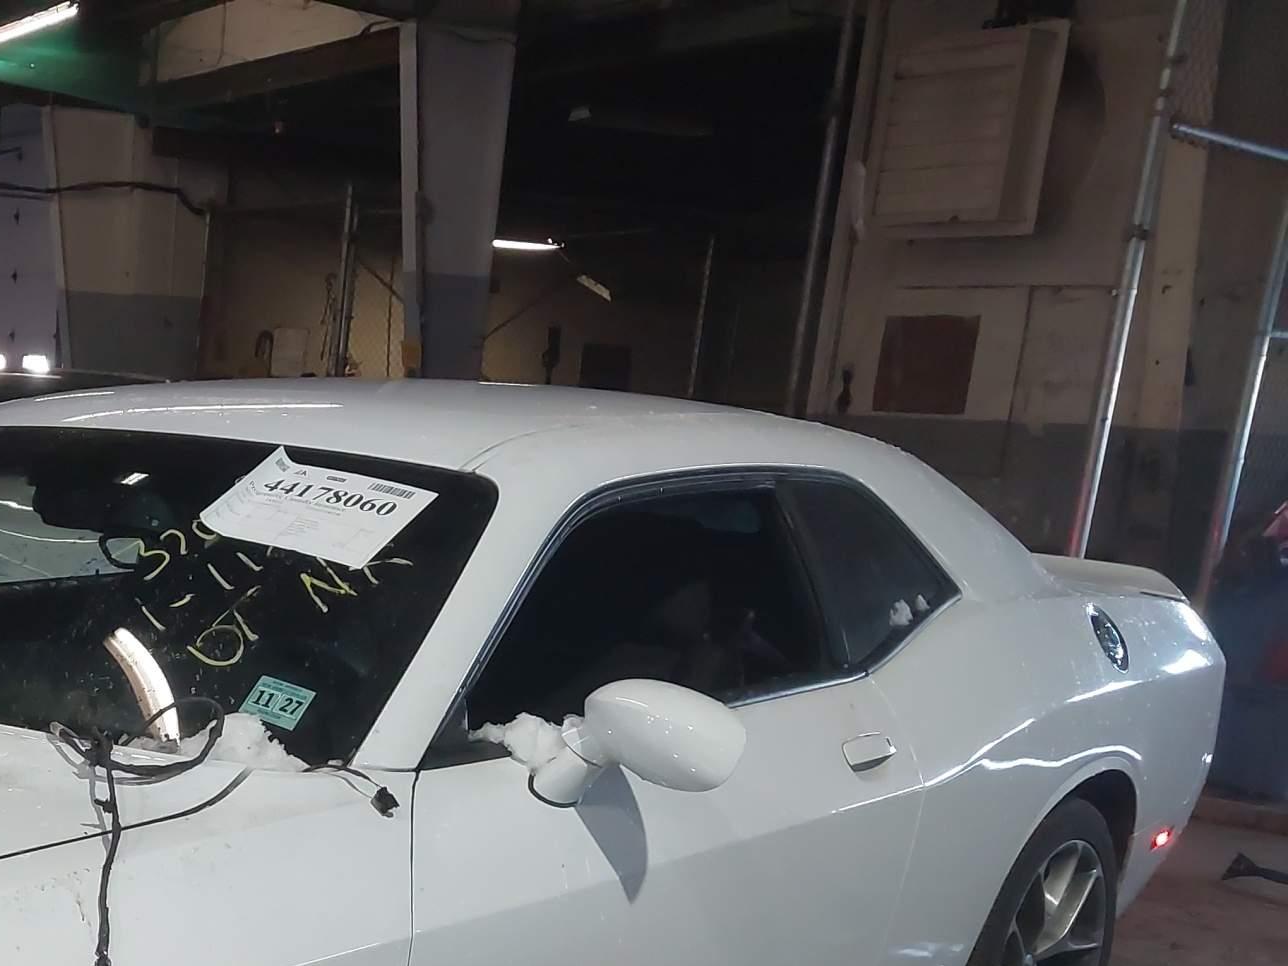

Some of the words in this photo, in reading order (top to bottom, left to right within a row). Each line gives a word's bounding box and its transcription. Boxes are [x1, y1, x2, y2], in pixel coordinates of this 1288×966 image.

[263, 479, 397, 516] 44178060
[252, 689, 274, 708] 11
[279, 697, 304, 715] 27
